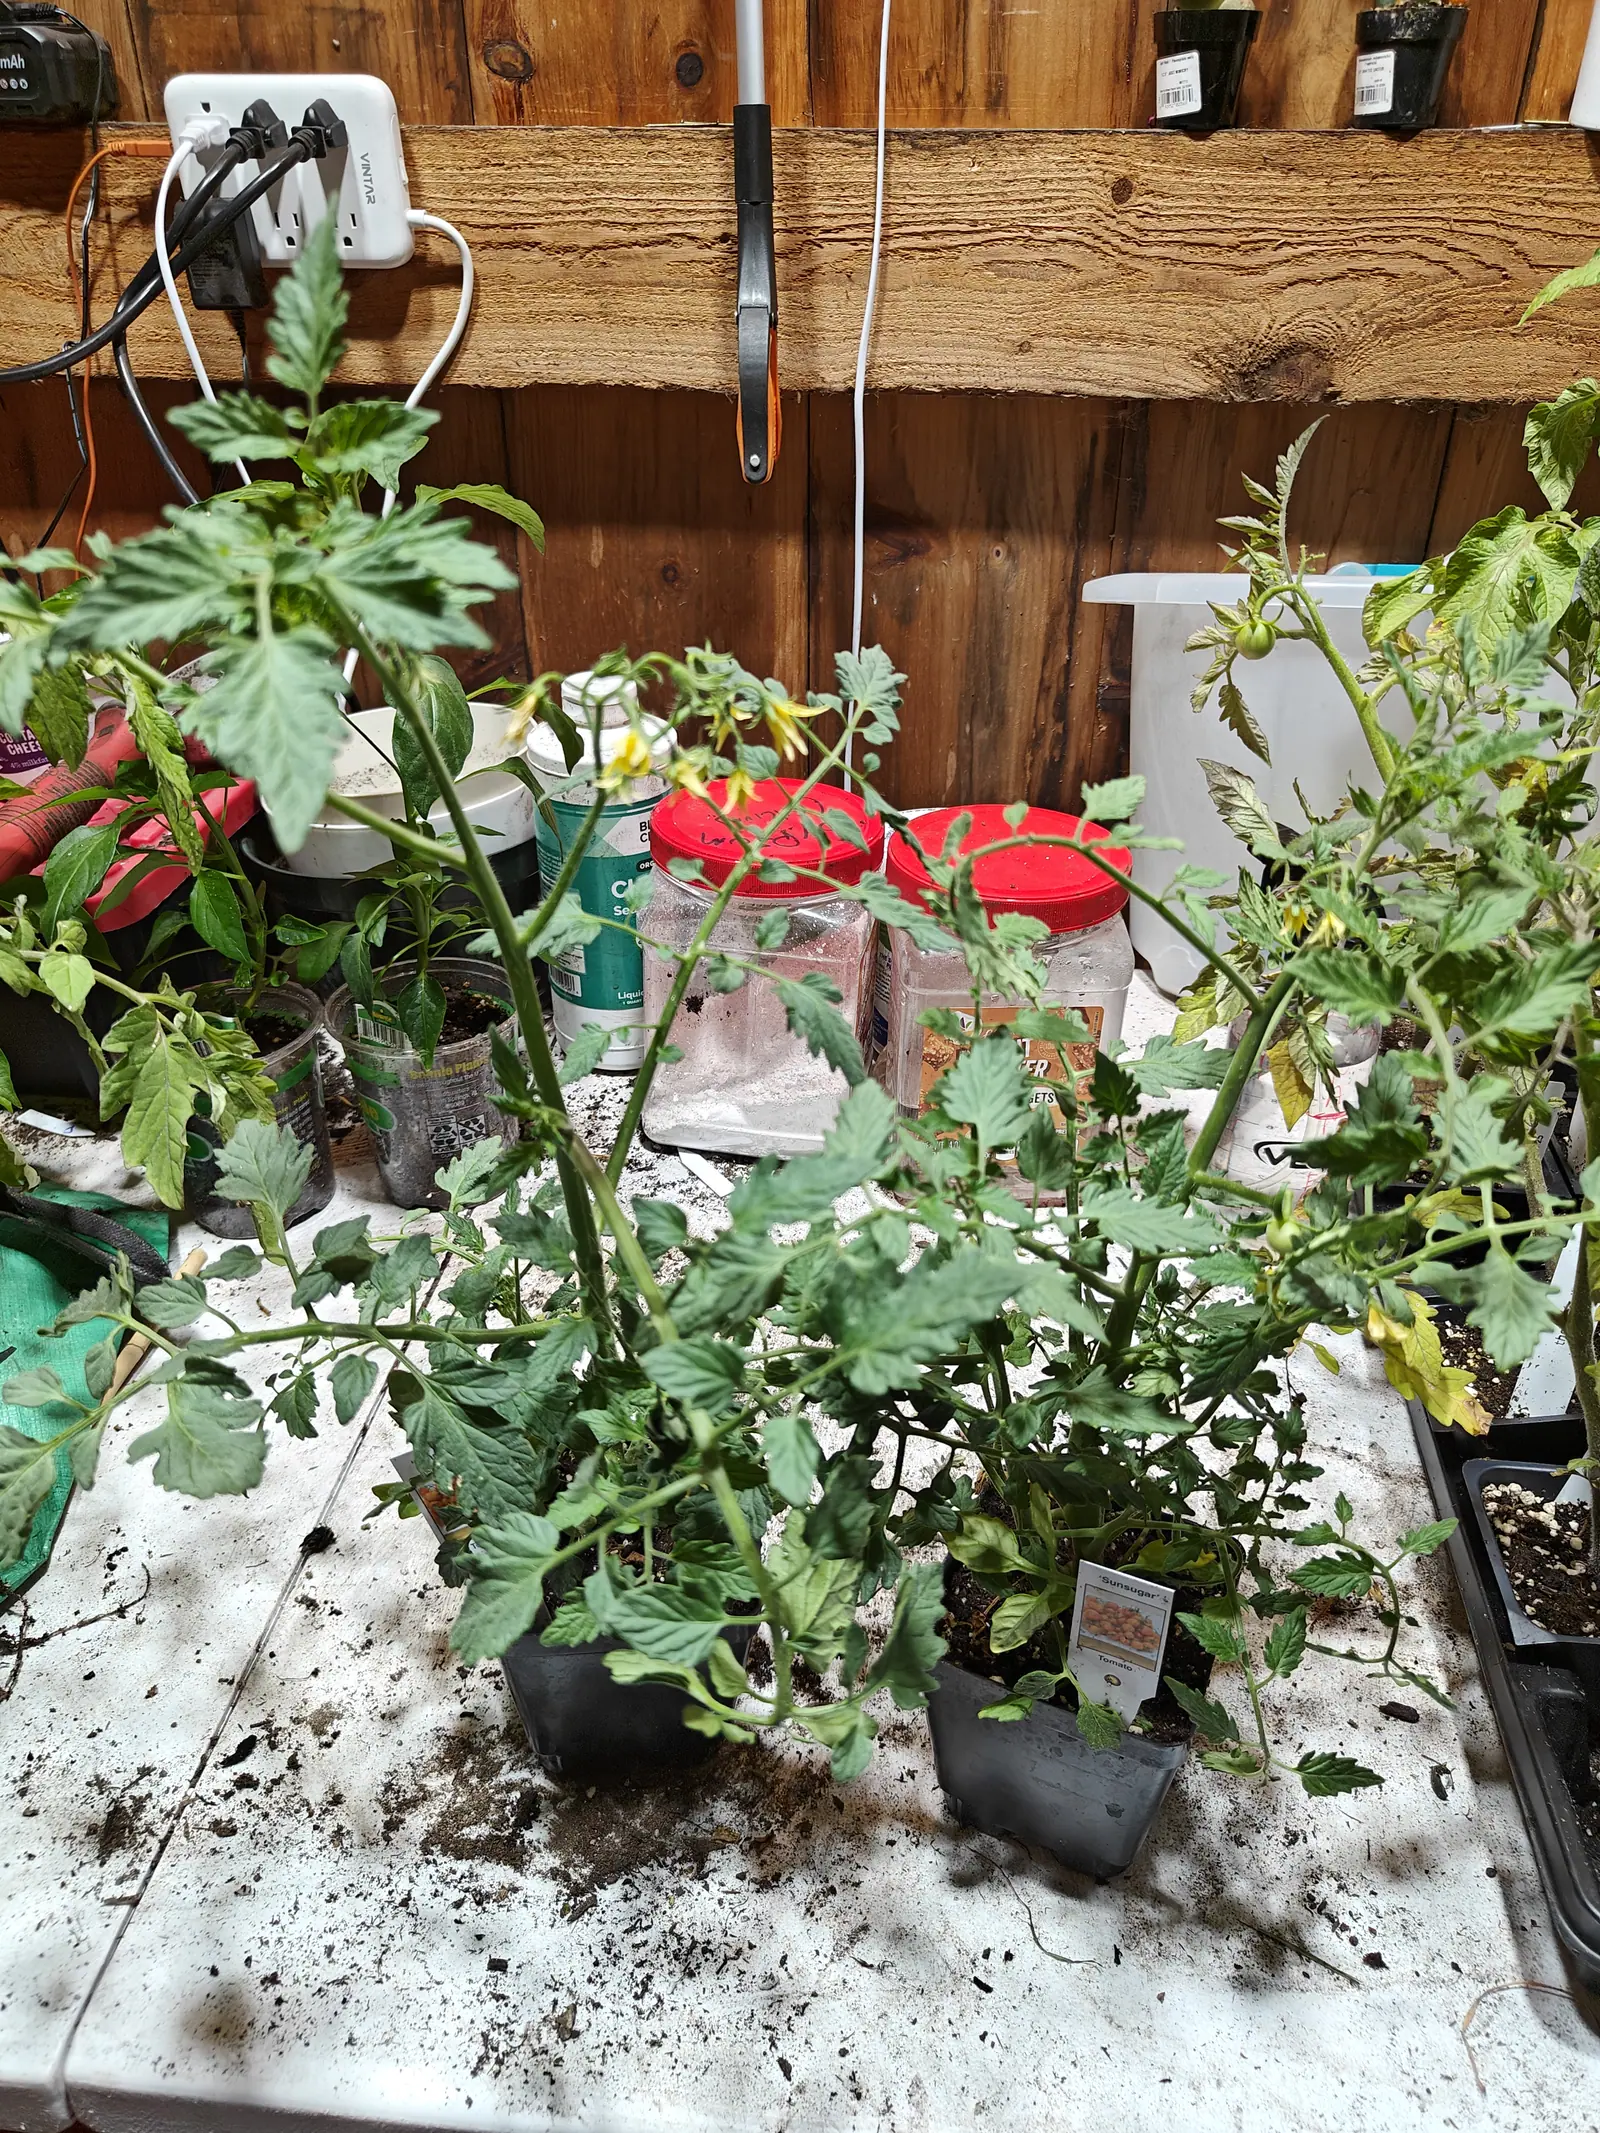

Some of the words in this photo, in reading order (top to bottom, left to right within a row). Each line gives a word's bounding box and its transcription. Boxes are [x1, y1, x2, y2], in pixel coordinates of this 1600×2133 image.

[0, 53, 25, 69] mAh
[360, 152, 376, 205] VINTAR
[6, 740, 43, 756] CHEES
[1098, 1655, 1133, 1672] Tomato
